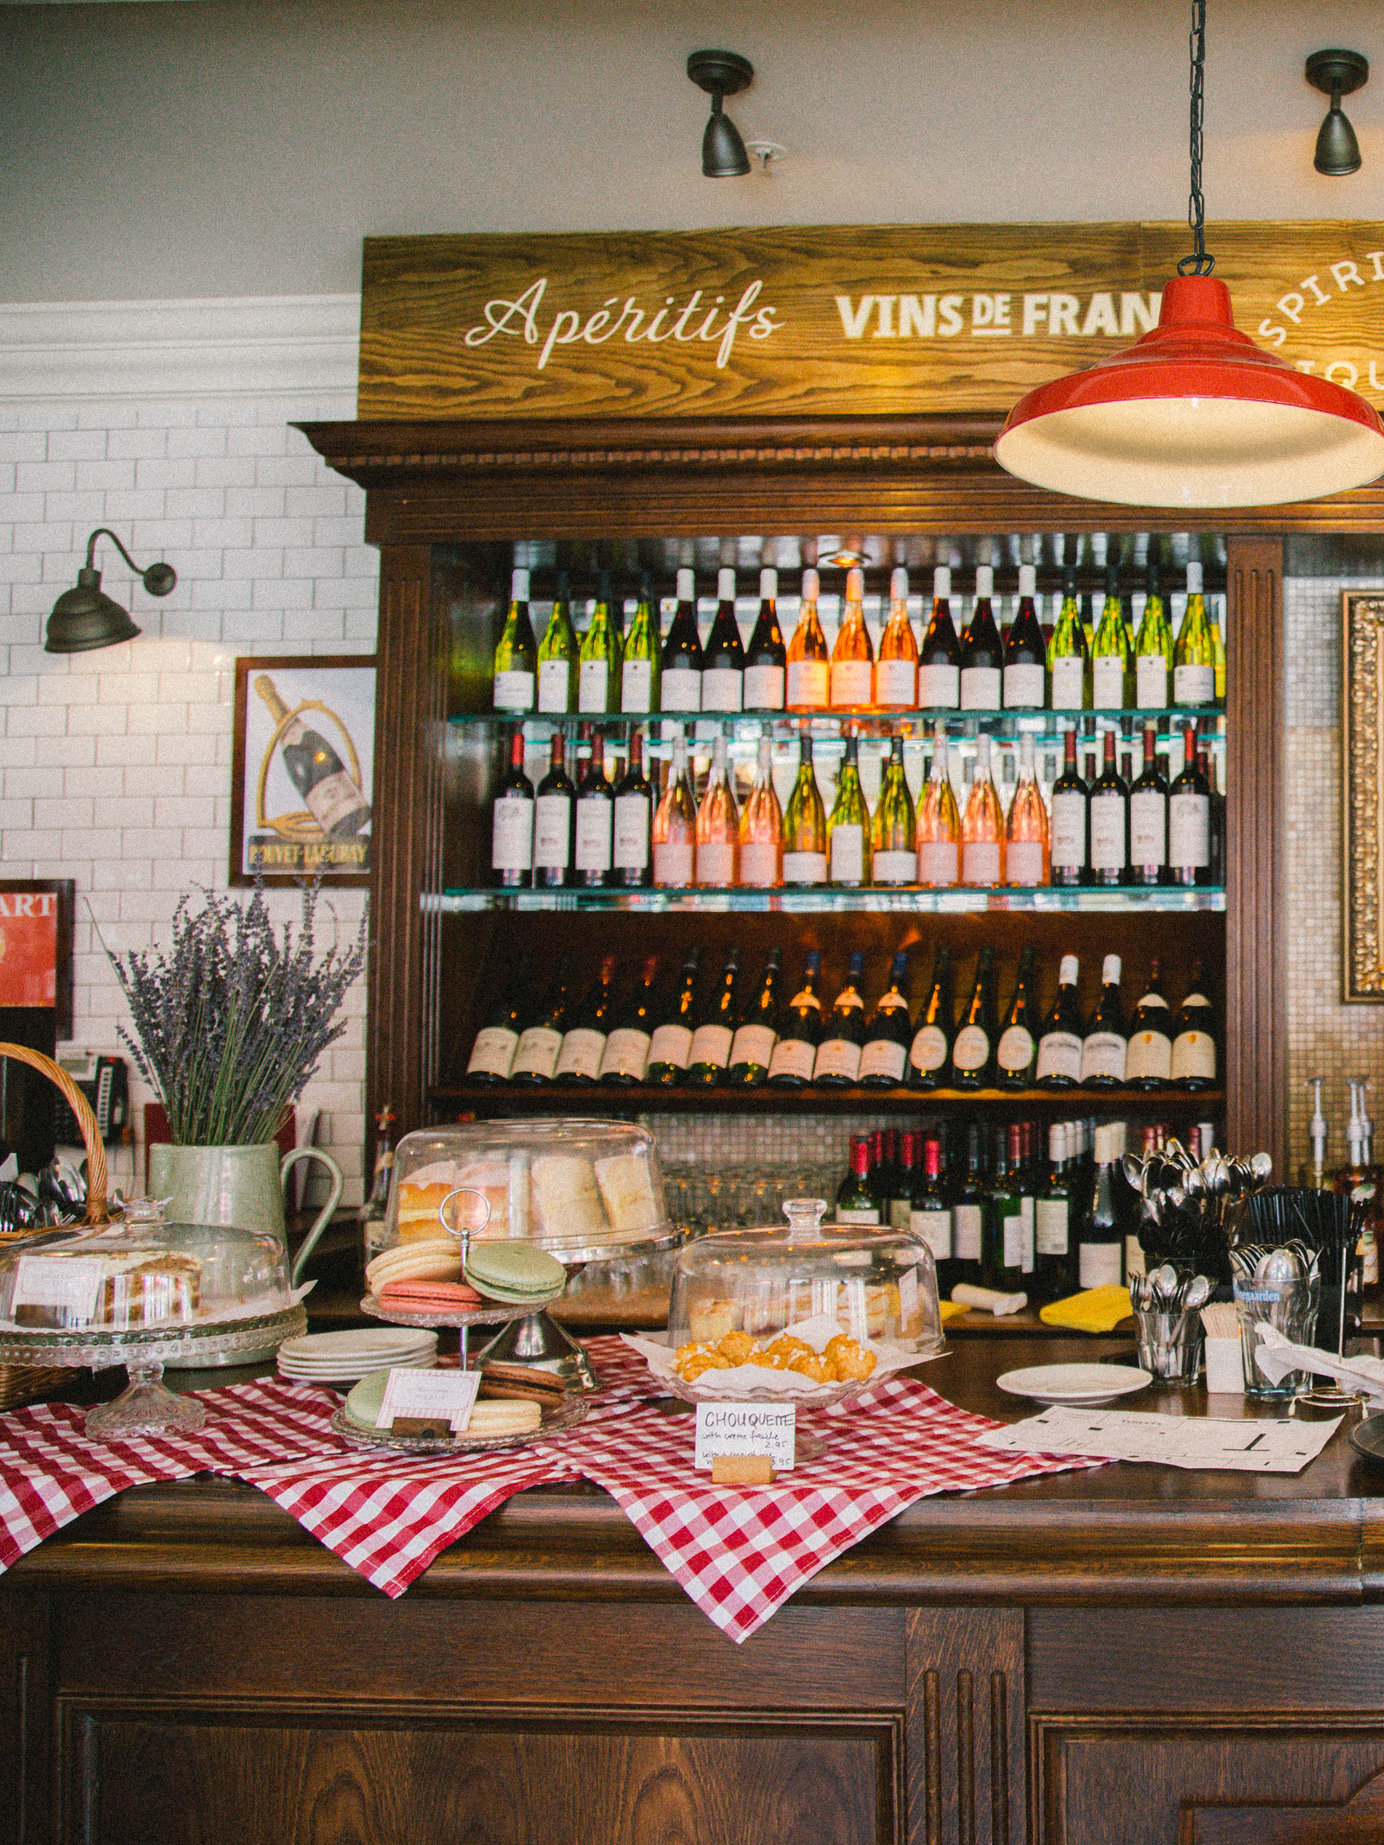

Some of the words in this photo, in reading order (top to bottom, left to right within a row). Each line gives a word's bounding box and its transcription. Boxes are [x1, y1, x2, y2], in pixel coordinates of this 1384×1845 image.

[465, 278, 785, 369] Apéritifs
[835, 293, 963, 339] VINS
[972, 294, 1011, 330] DE
[1022, 292, 1160, 338] FRAN
[705, 1411, 796, 1429] CHOUQUETTE
